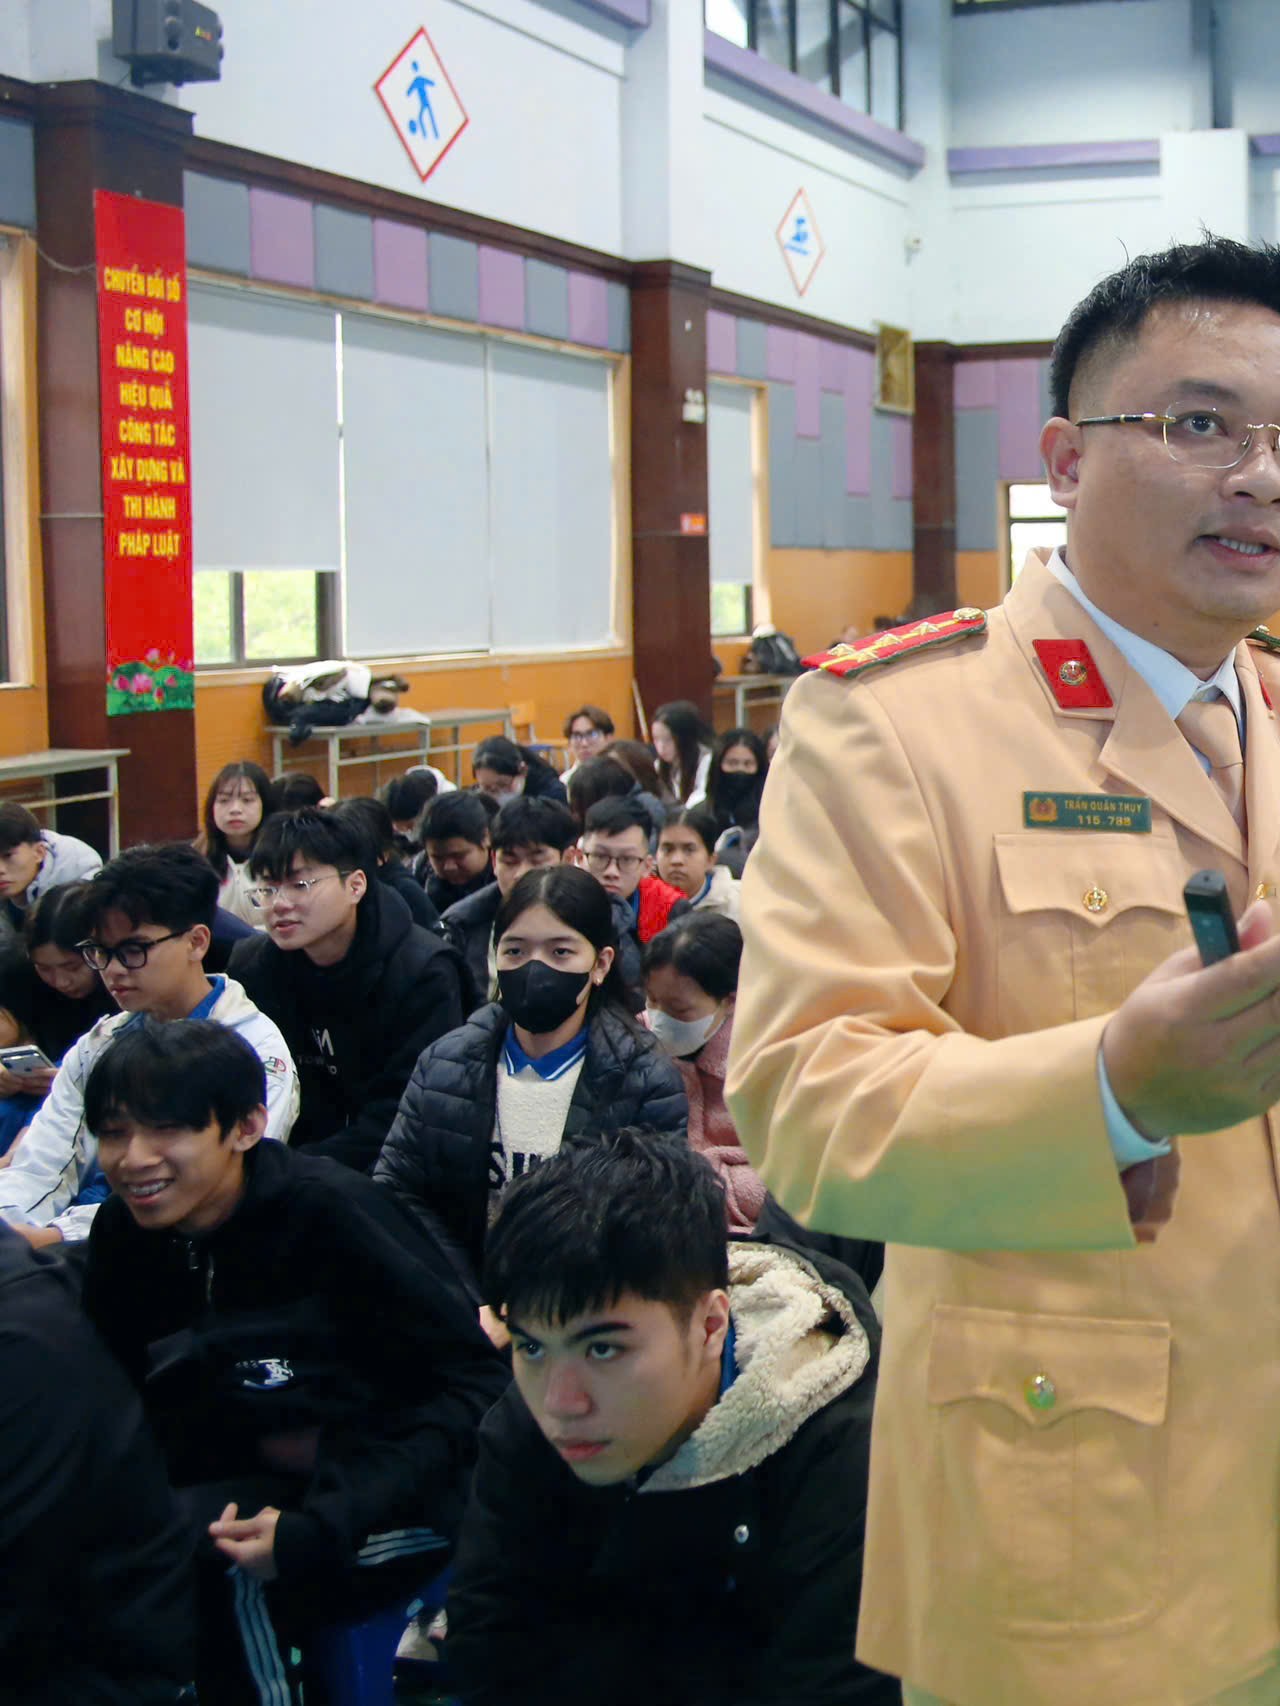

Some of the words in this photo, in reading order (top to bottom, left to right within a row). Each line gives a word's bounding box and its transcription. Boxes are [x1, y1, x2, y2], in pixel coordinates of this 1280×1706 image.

[151, 349, 175, 374] CAO
[119, 417, 152, 445] CÔNG
[153, 419, 176, 447] TÁC
[123, 495, 142, 519] THI
[118, 528, 151, 557] PHÁP
[153, 529, 181, 561] LUẬT
